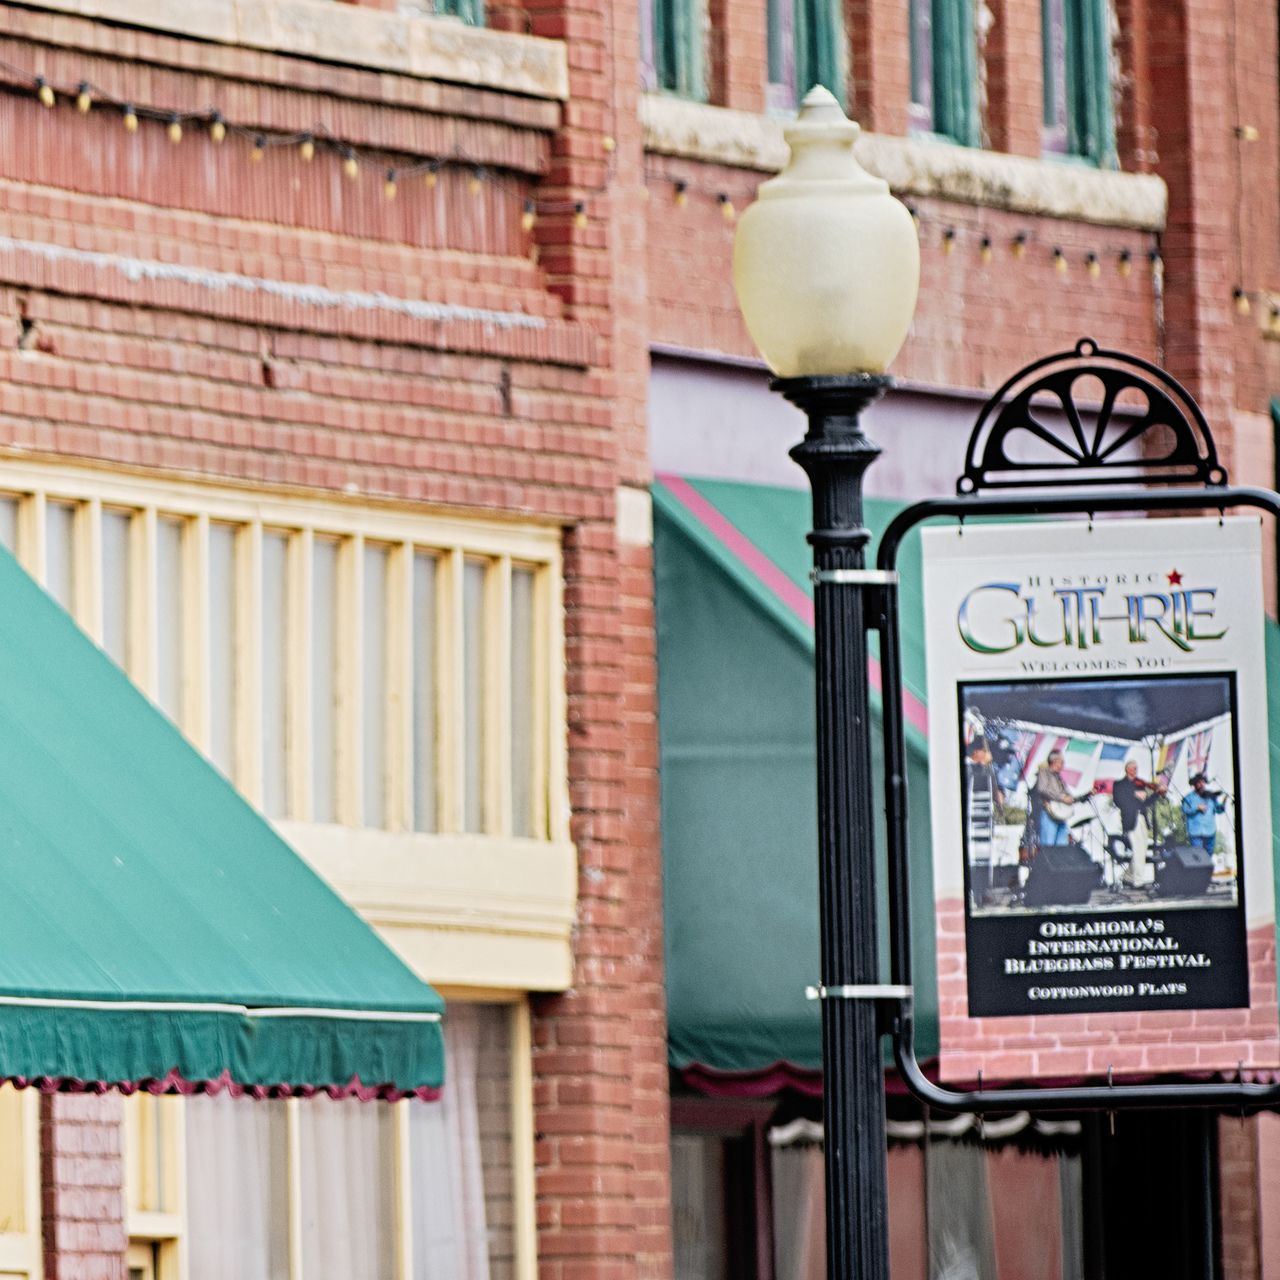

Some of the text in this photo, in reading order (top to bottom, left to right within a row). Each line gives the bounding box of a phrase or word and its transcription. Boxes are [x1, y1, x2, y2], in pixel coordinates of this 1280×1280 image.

[1027, 573, 1160, 587] HISTORIC
[957, 581, 1230, 654] GUTHRIE
[1020, 655, 1173, 673] WELCOMES YOU
[1039, 918, 1166, 939] OKLAHOMA'S
[1028, 937, 1179, 956] INTERNATIONAL
[1003, 953, 1212, 975] BLUEGRASS FESTIVAL
[1026, 981, 1189, 1001] COTTONWOOD FLATS
